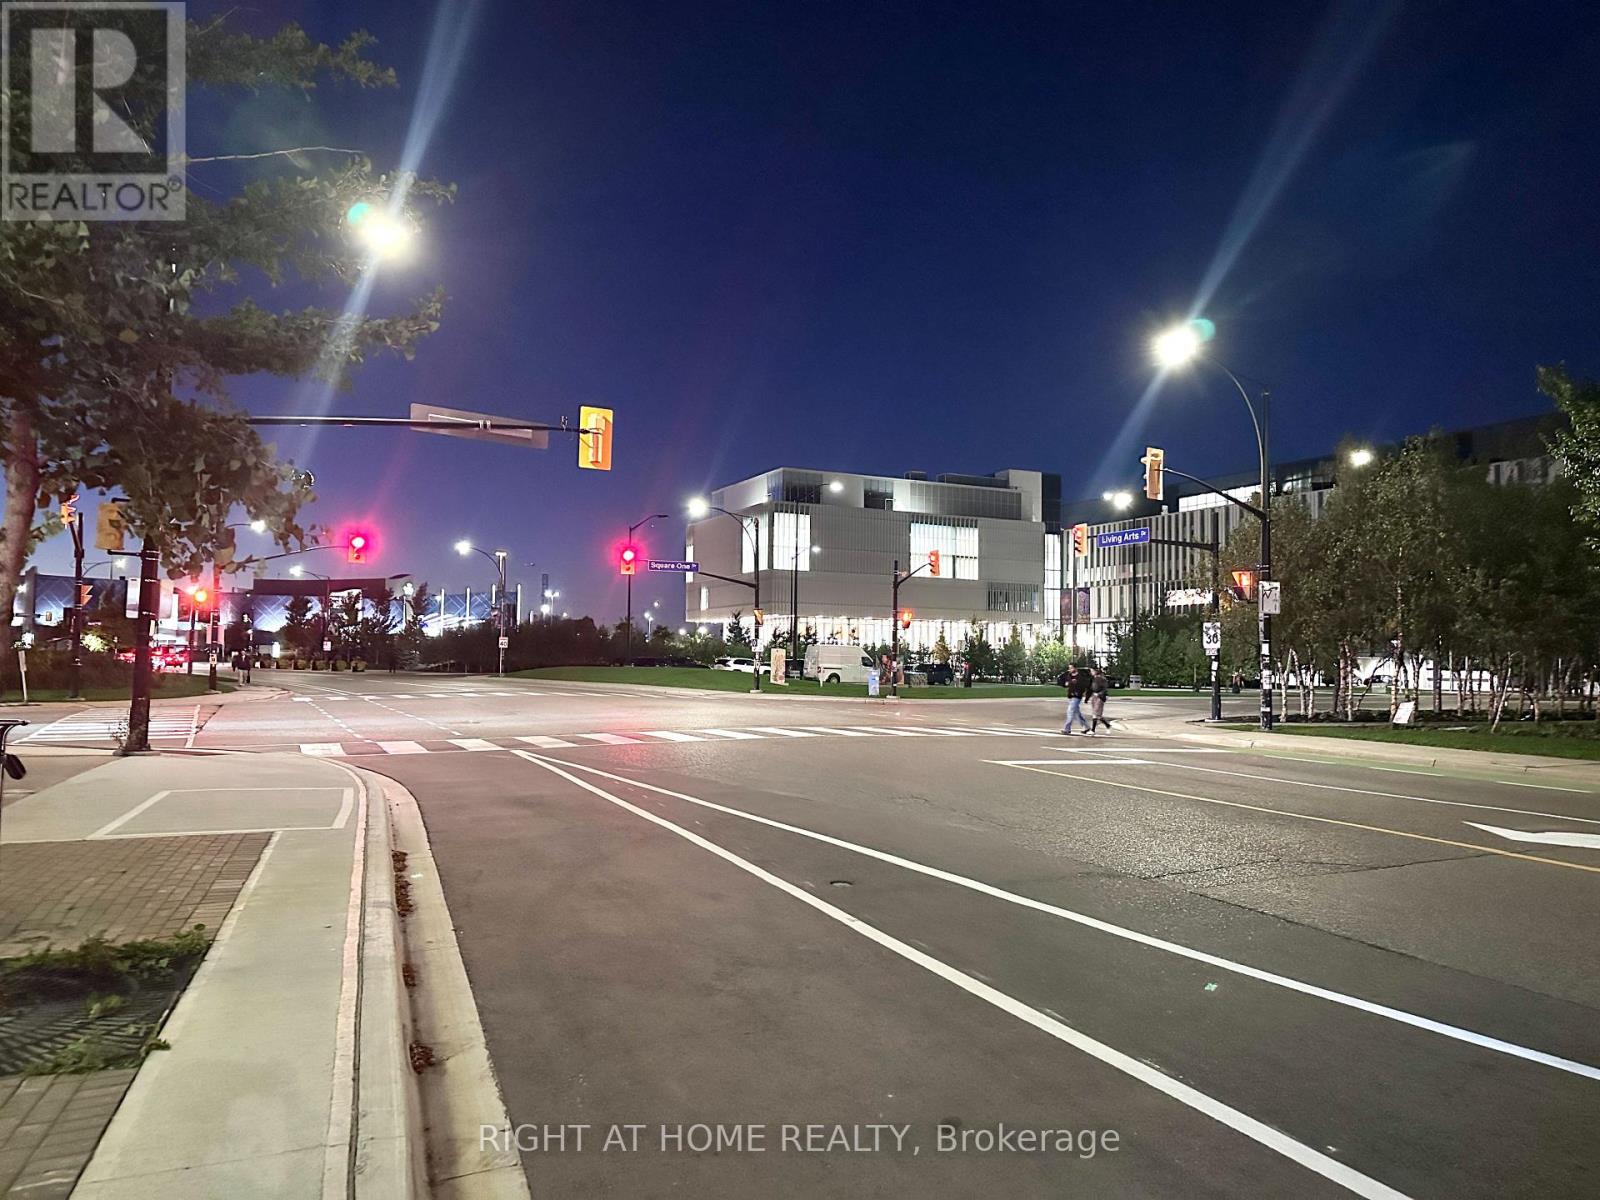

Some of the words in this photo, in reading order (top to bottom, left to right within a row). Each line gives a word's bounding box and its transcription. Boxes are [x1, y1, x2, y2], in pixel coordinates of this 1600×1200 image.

[1101, 534, 1122, 544] Living
[1123, 532, 1139, 541] Arts
[650, 562, 675, 570] Square
[676, 562, 691, 570] One
